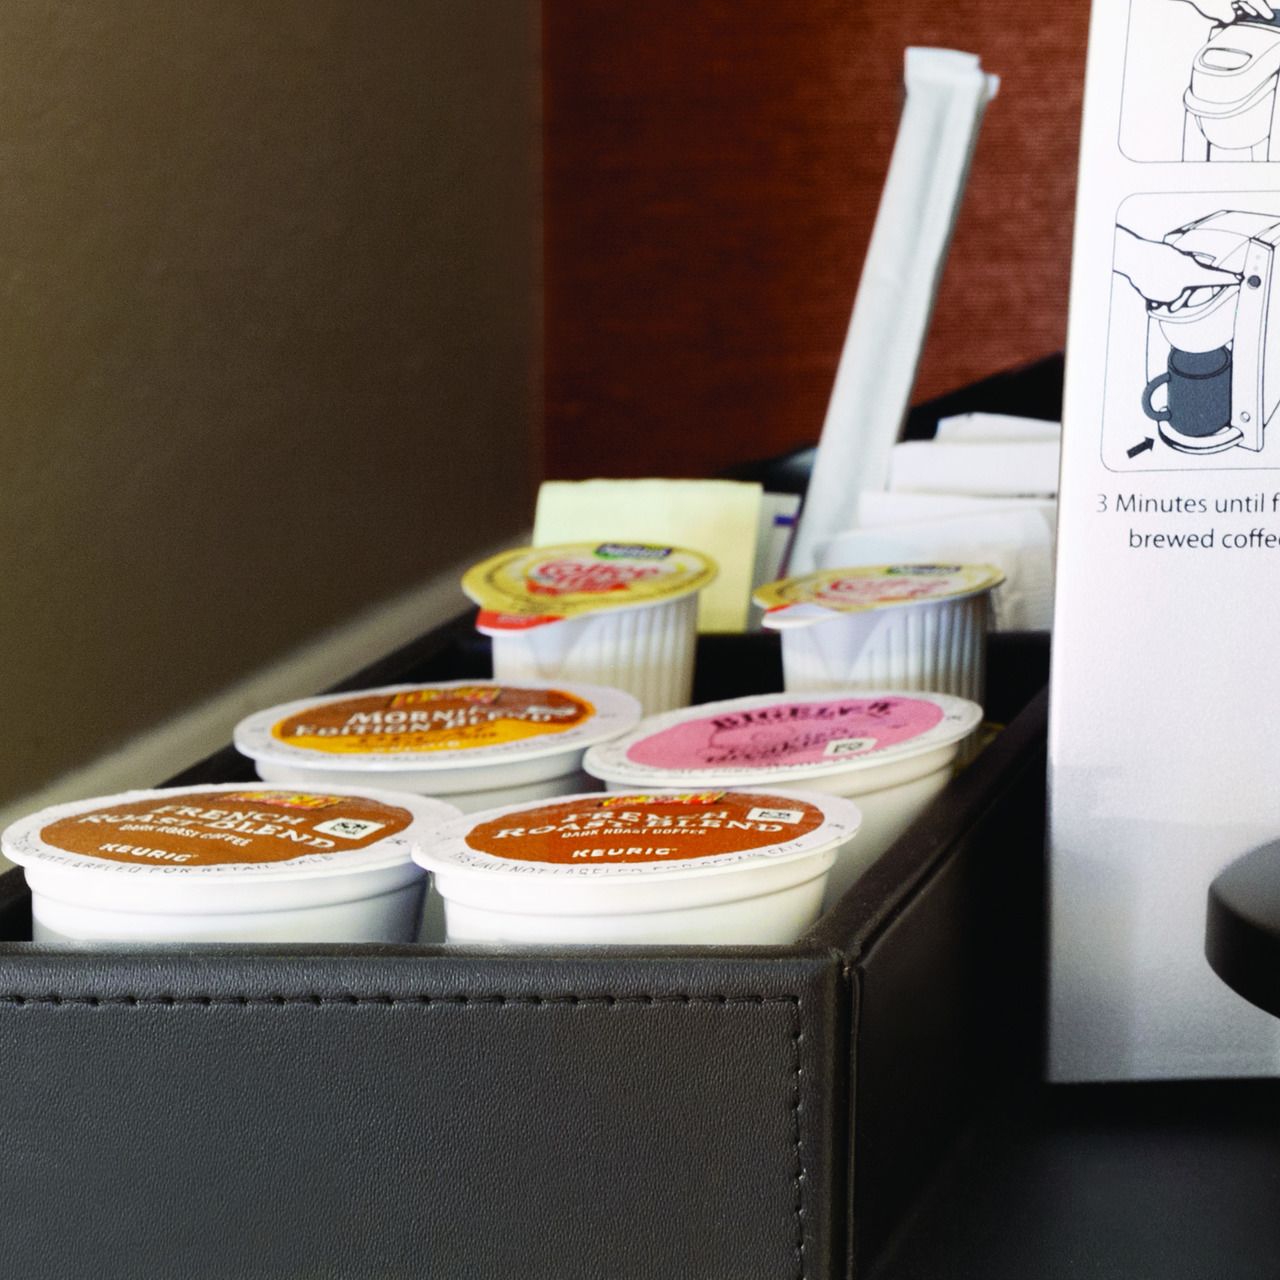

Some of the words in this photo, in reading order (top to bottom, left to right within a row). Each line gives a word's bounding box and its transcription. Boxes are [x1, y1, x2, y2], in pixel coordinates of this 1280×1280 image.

[1096, 494, 1107, 513] 3
[1116, 494, 1208, 513] Minutes
[1215, 493, 1265, 513] until
[1129, 528, 1214, 548] brewed
[151, 805, 305, 826] FRENCH
[560, 811, 729, 824] FRENCH
[203, 819, 336, 849] BLEND
[492, 820, 632, 840] ROAST
[647, 819, 784, 833] BLEND
[561, 830, 599, 839] DARK
[99, 842, 193, 863] KEURIG
[571, 846, 677, 859] KEURIG
